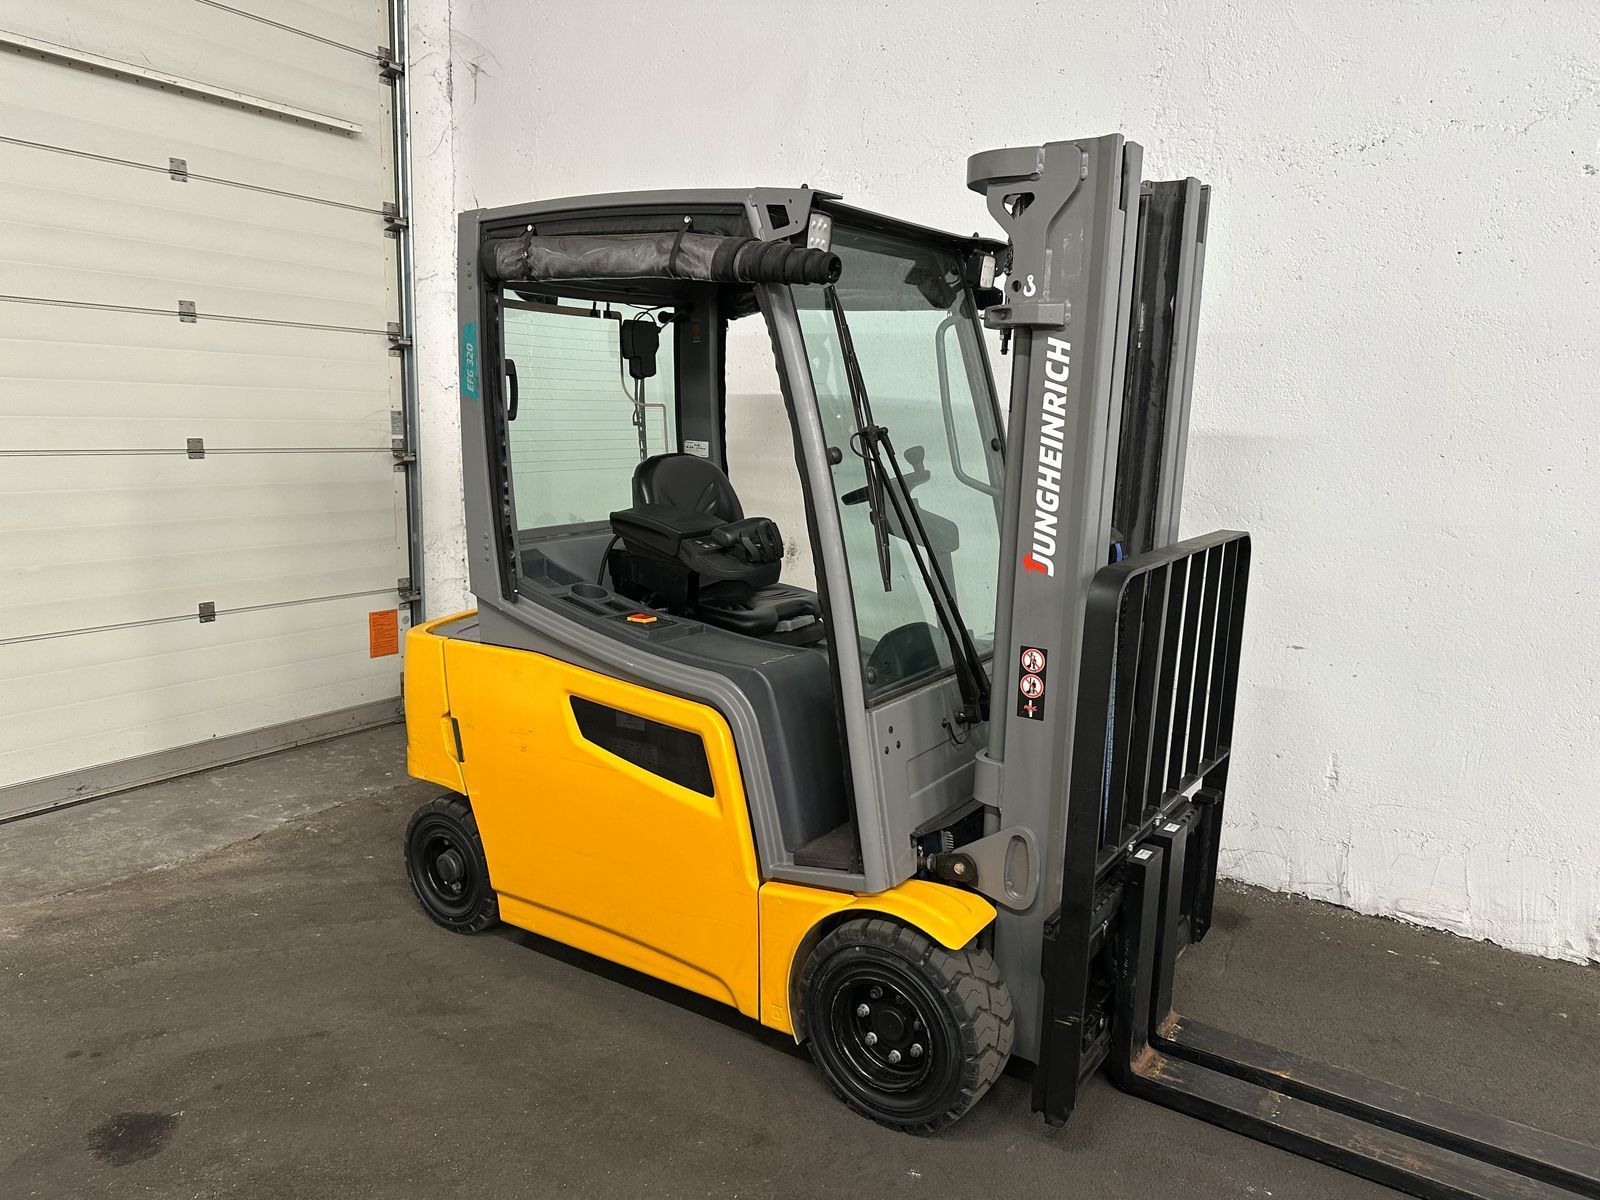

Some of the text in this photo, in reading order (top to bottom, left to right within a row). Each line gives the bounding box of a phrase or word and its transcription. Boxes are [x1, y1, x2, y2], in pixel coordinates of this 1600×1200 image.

[466, 342, 475, 392] EFG 320
[1023, 336, 1072, 577] JUNGHEINRICH
